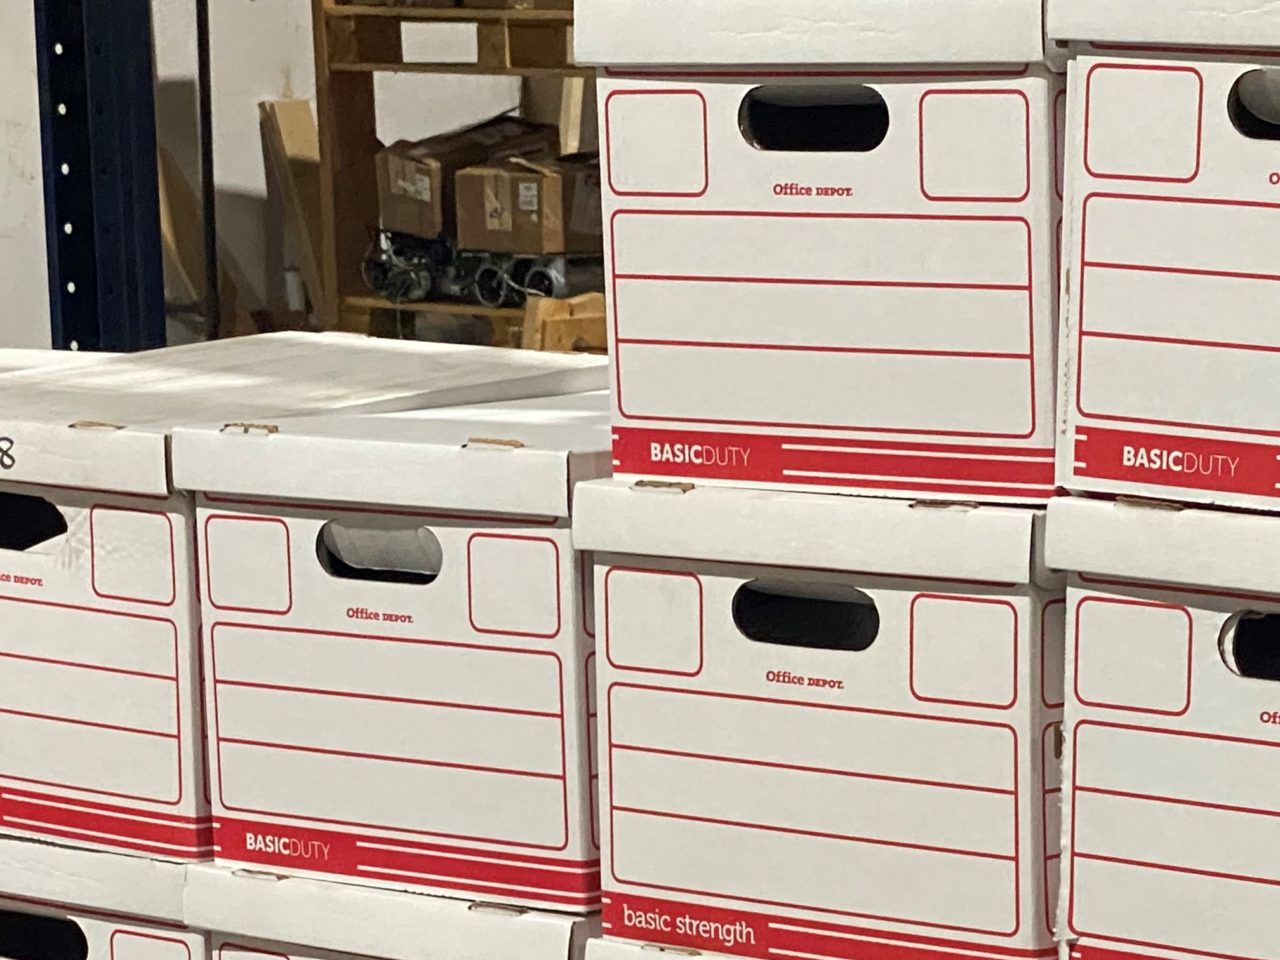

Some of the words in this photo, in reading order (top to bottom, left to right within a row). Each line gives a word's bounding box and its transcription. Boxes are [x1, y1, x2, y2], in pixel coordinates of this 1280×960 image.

[773, 182, 814, 197] Office
[347, 607, 382, 621] Office
[766, 671, 806, 686] Office
[622, 903, 672, 932] basic
[675, 914, 756, 947] strength
